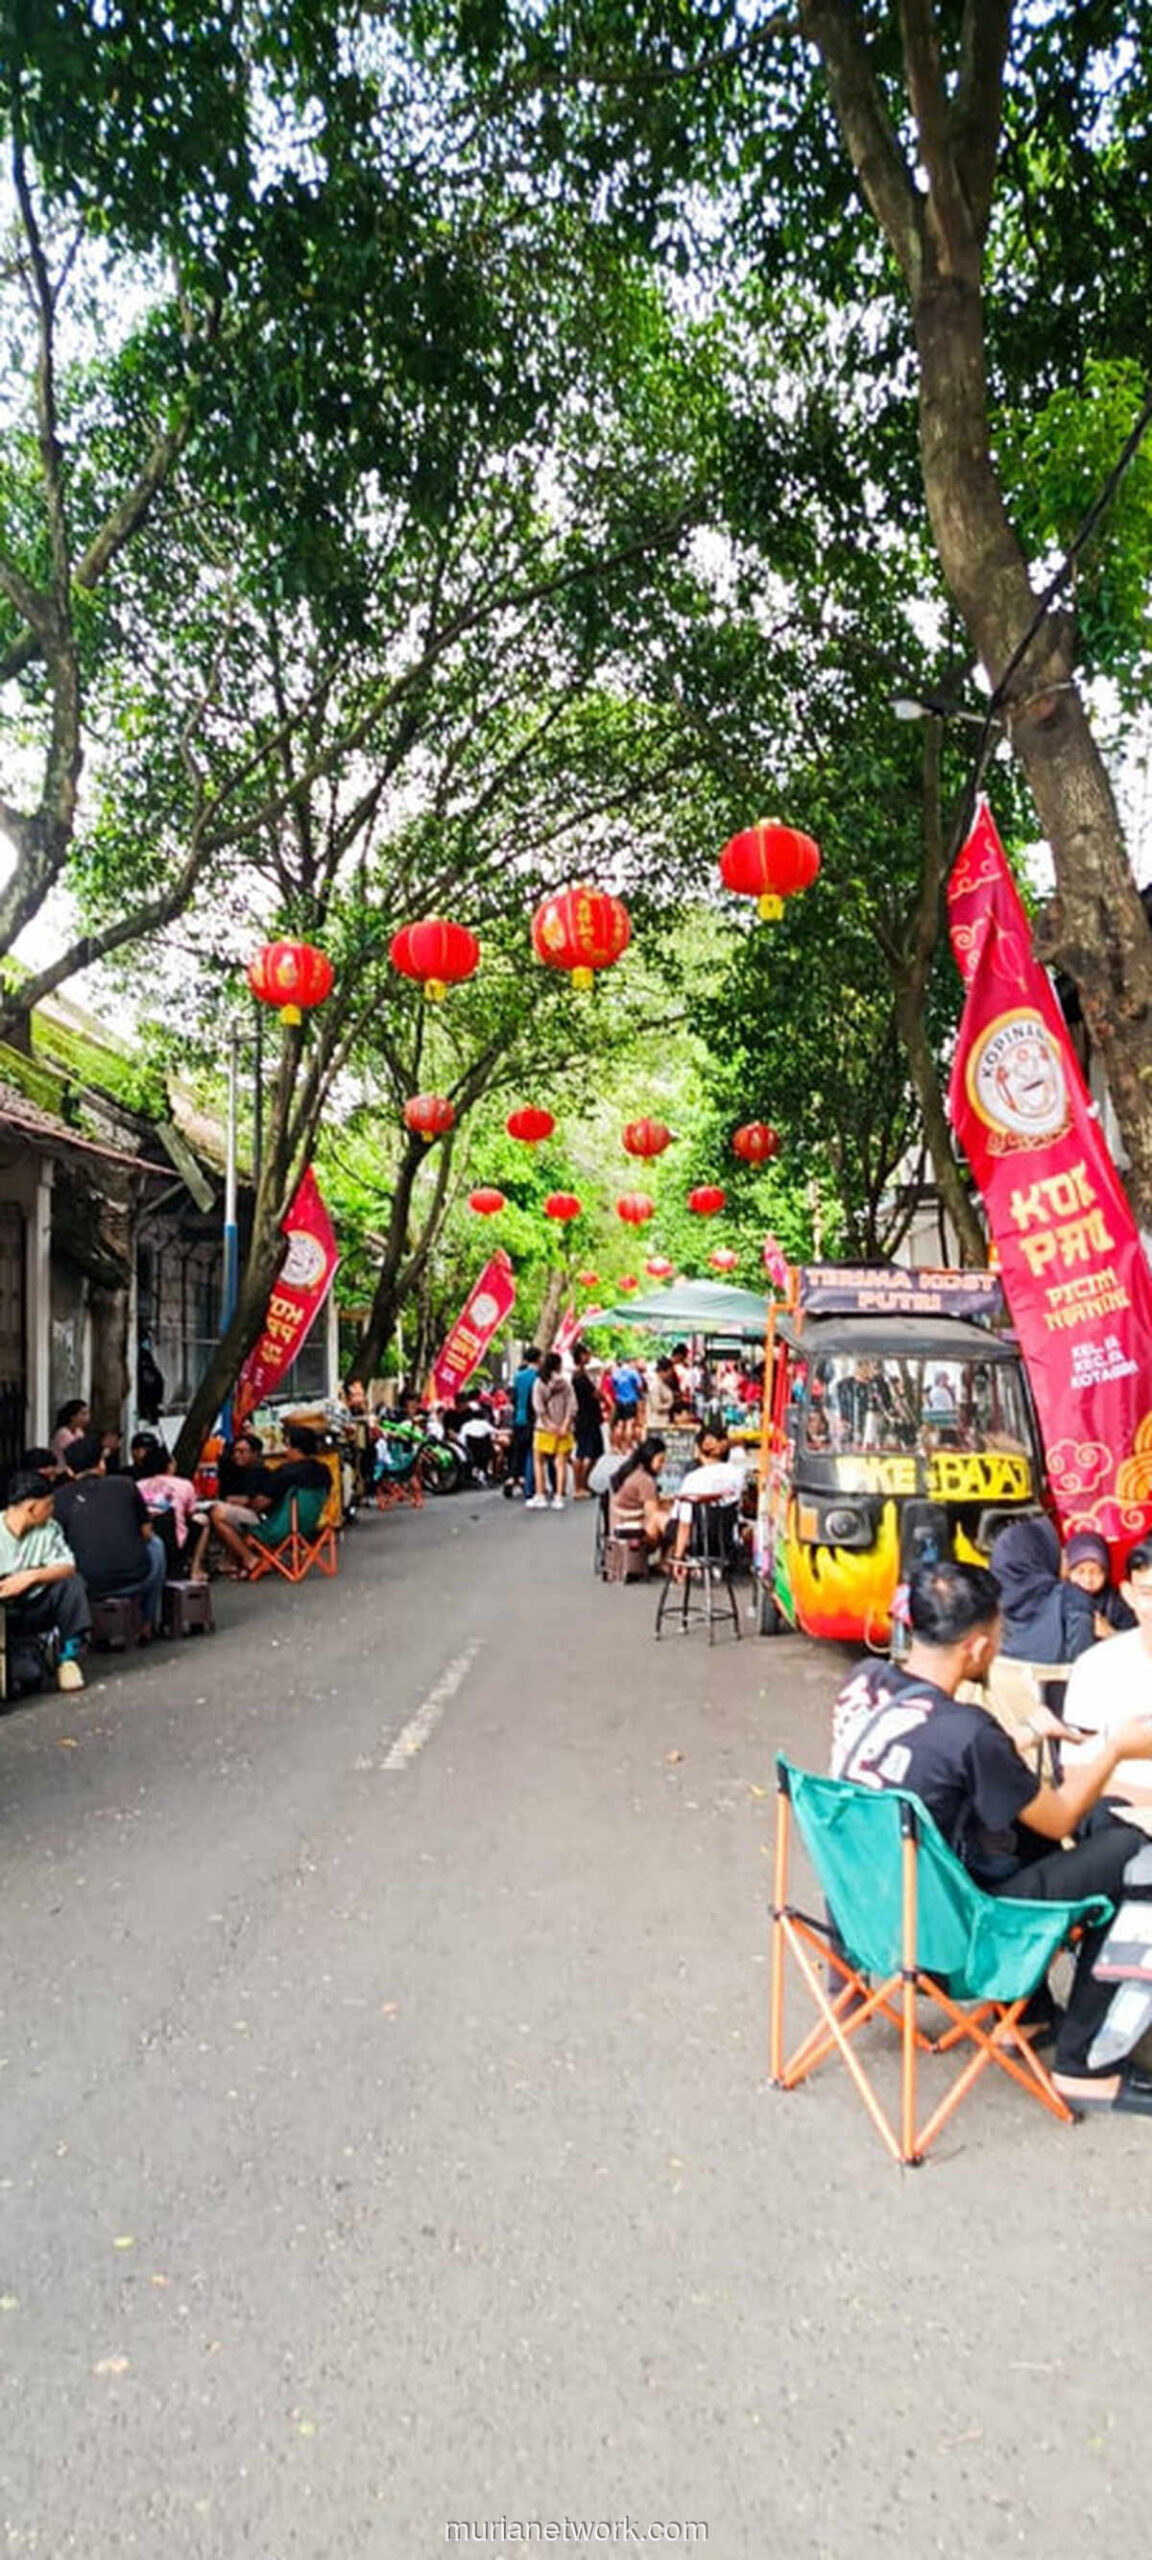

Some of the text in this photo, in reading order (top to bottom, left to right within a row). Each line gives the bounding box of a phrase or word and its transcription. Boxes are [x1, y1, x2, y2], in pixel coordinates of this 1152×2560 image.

[805, 1268, 996, 1292] TERIMA KOST
[856, 1290, 942, 1311] PUTRI
